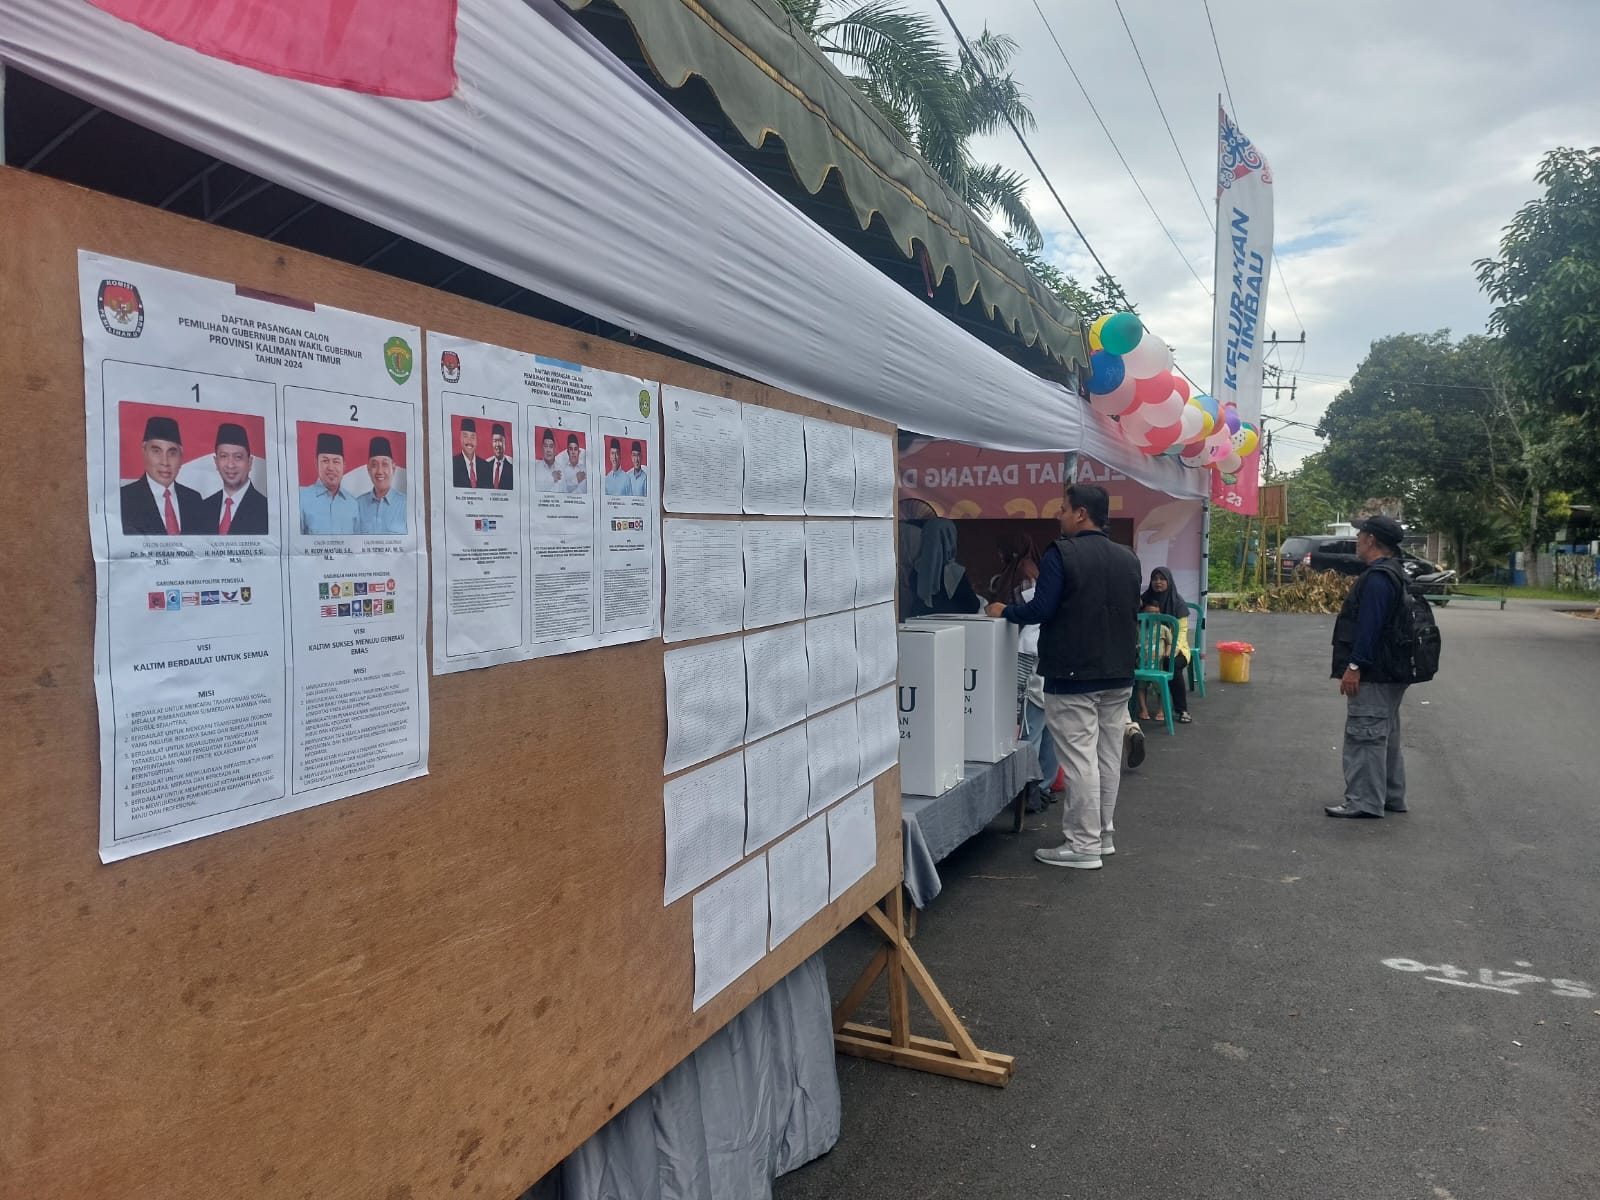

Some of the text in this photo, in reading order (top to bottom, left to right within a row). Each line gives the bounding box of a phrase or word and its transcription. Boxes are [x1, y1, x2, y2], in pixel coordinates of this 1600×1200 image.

[1237, 251, 1263, 363] TIMBAU
[221, 314, 329, 342] DAFTAR PASANGAN CALON
[178, 317, 362, 359] PEMILIHAN GUBERNUR DAN WAKIL GUBERNUR
[209, 334, 341, 365] PROVINSI KALIMANTAN TIMUR
[255, 354, 303, 368] TAHUN 2024
[191, 384, 200, 403] 1
[350, 404, 359, 422] 2
[558, 416, 562, 426] 2
[309, 643, 330, 651] KALTIM
[381, 634, 405, 642] GENERASI
[133, 650, 269, 672] KALTIM BERDAULAT UNTUK SEMUA
[198, 690, 215, 698] MISI
